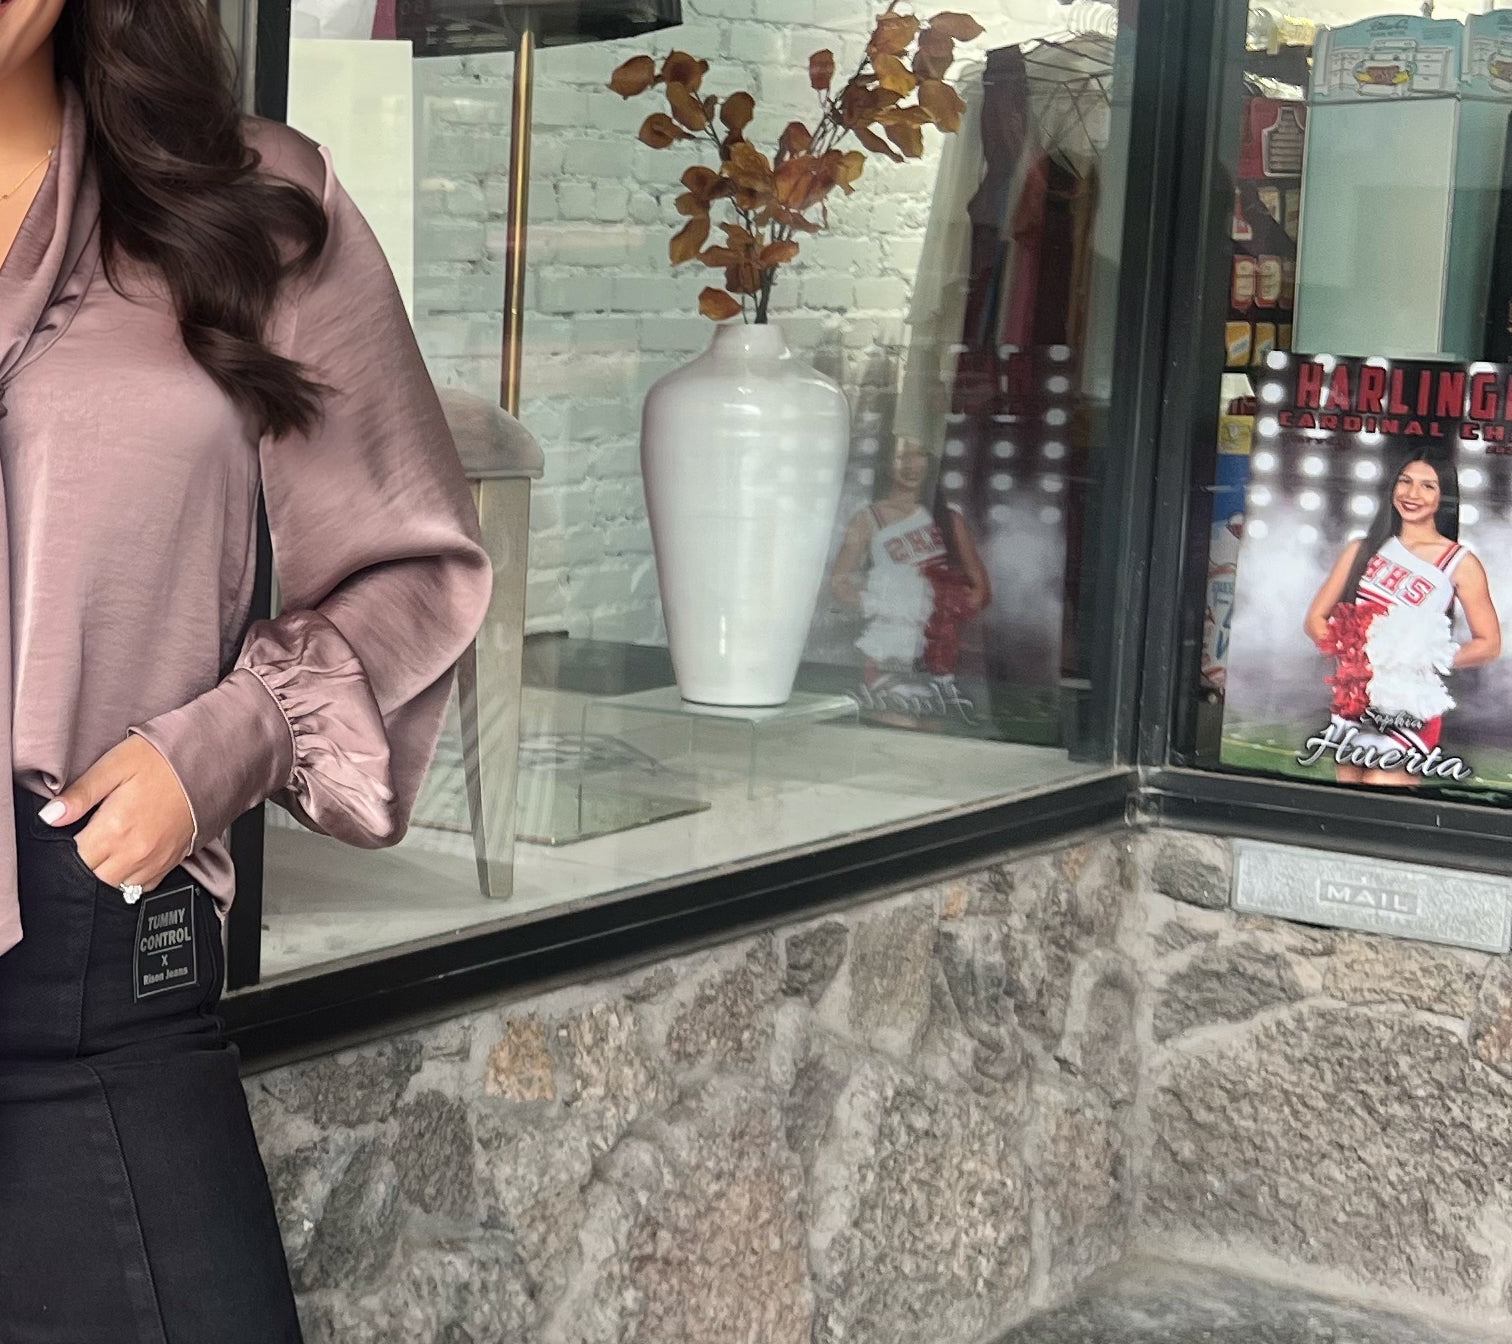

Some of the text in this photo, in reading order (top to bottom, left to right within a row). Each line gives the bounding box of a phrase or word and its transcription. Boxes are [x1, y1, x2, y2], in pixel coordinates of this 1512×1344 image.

[1296, 362, 1512, 421] HARLING
[1279, 411, 1512, 443] CARDINAL CH
[1296, 722, 1474, 782] Huerta
[1326, 884, 1409, 912] MAIL
[149, 908, 186, 931] TUMMY
[140, 927, 191, 952] CONTROL
[166, 967, 188, 979] Jeans
